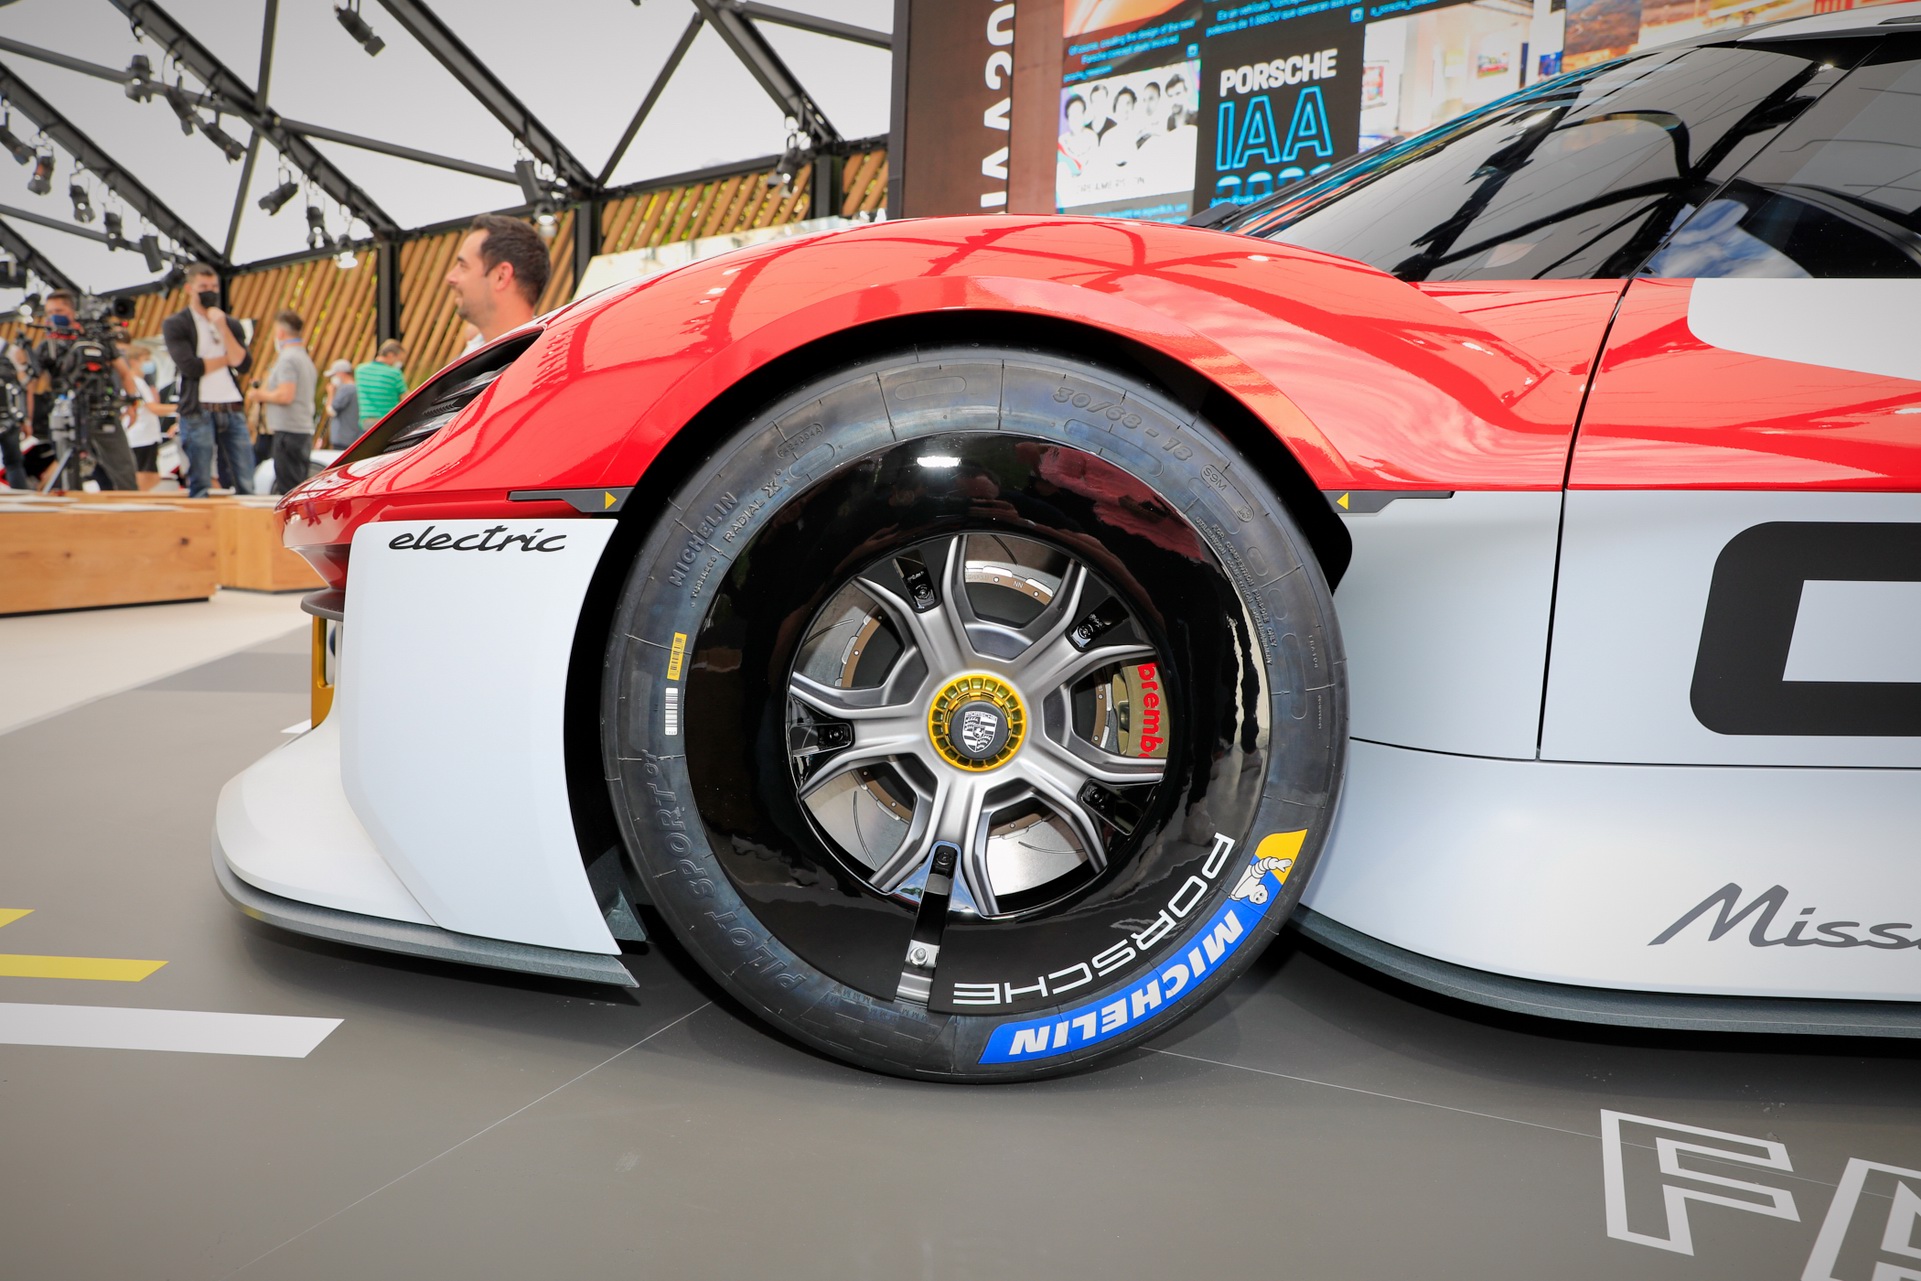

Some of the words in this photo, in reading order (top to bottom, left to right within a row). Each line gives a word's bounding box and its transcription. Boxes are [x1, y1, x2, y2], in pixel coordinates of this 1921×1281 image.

[1220, 48, 1338, 97] PORSCHE
[1216, 85, 1334, 172] IAA
[1053, 386, 1142, 429] 30/68
[1202, 468, 1227, 491] S9M
[388, 525, 567, 554] electric
[668, 491, 737, 587] MICHELIN
[723, 498, 765, 543] RADIAL
[1211, 523, 1225, 540] FOR
[1225, 541, 1255, 587] COMPETITION
[1137, 662, 1164, 758] bremb
[646, 781, 717, 899] SPORT
[704, 909, 807, 991] PILOT
[953, 832, 1236, 1006] PORSCHE
[1647, 882, 1921, 950] Miss
[1008, 909, 1244, 1056] MICHELIN
